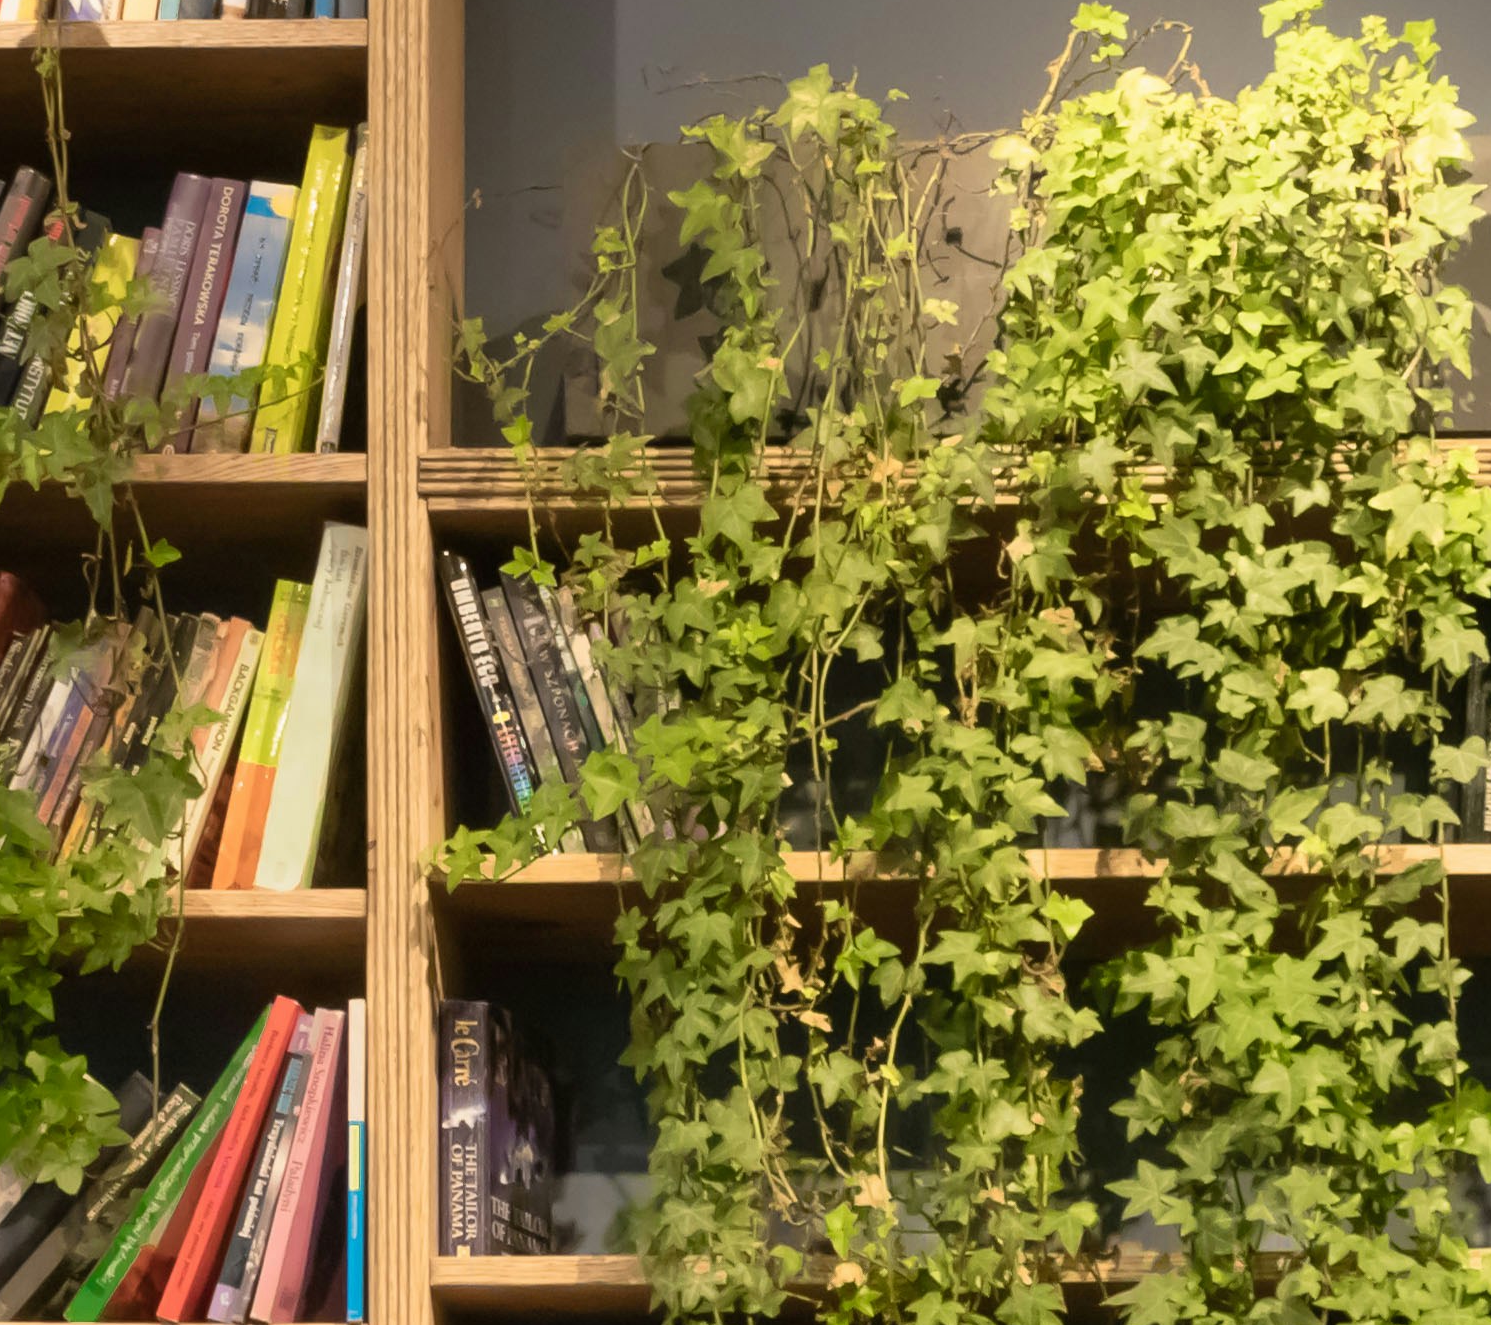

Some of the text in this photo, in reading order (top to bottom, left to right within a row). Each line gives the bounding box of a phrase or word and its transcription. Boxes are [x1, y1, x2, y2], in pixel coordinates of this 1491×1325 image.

[192, 184, 234, 327] DOROTA TERAKOWSKA
[447, 576, 499, 689] UMBERTO ECO
[204, 661, 255, 753] BACKGAMMON
[541, 667, 582, 754] SZPONACH
[314, 1024, 336, 1067] Halina
[452, 1018, 474, 1036] le
[293, 1065, 326, 1145] Snopkiewicz
[445, 1142, 468, 1240] OF PANAMA
[458, 1142, 481, 1241] THE TAILOR
